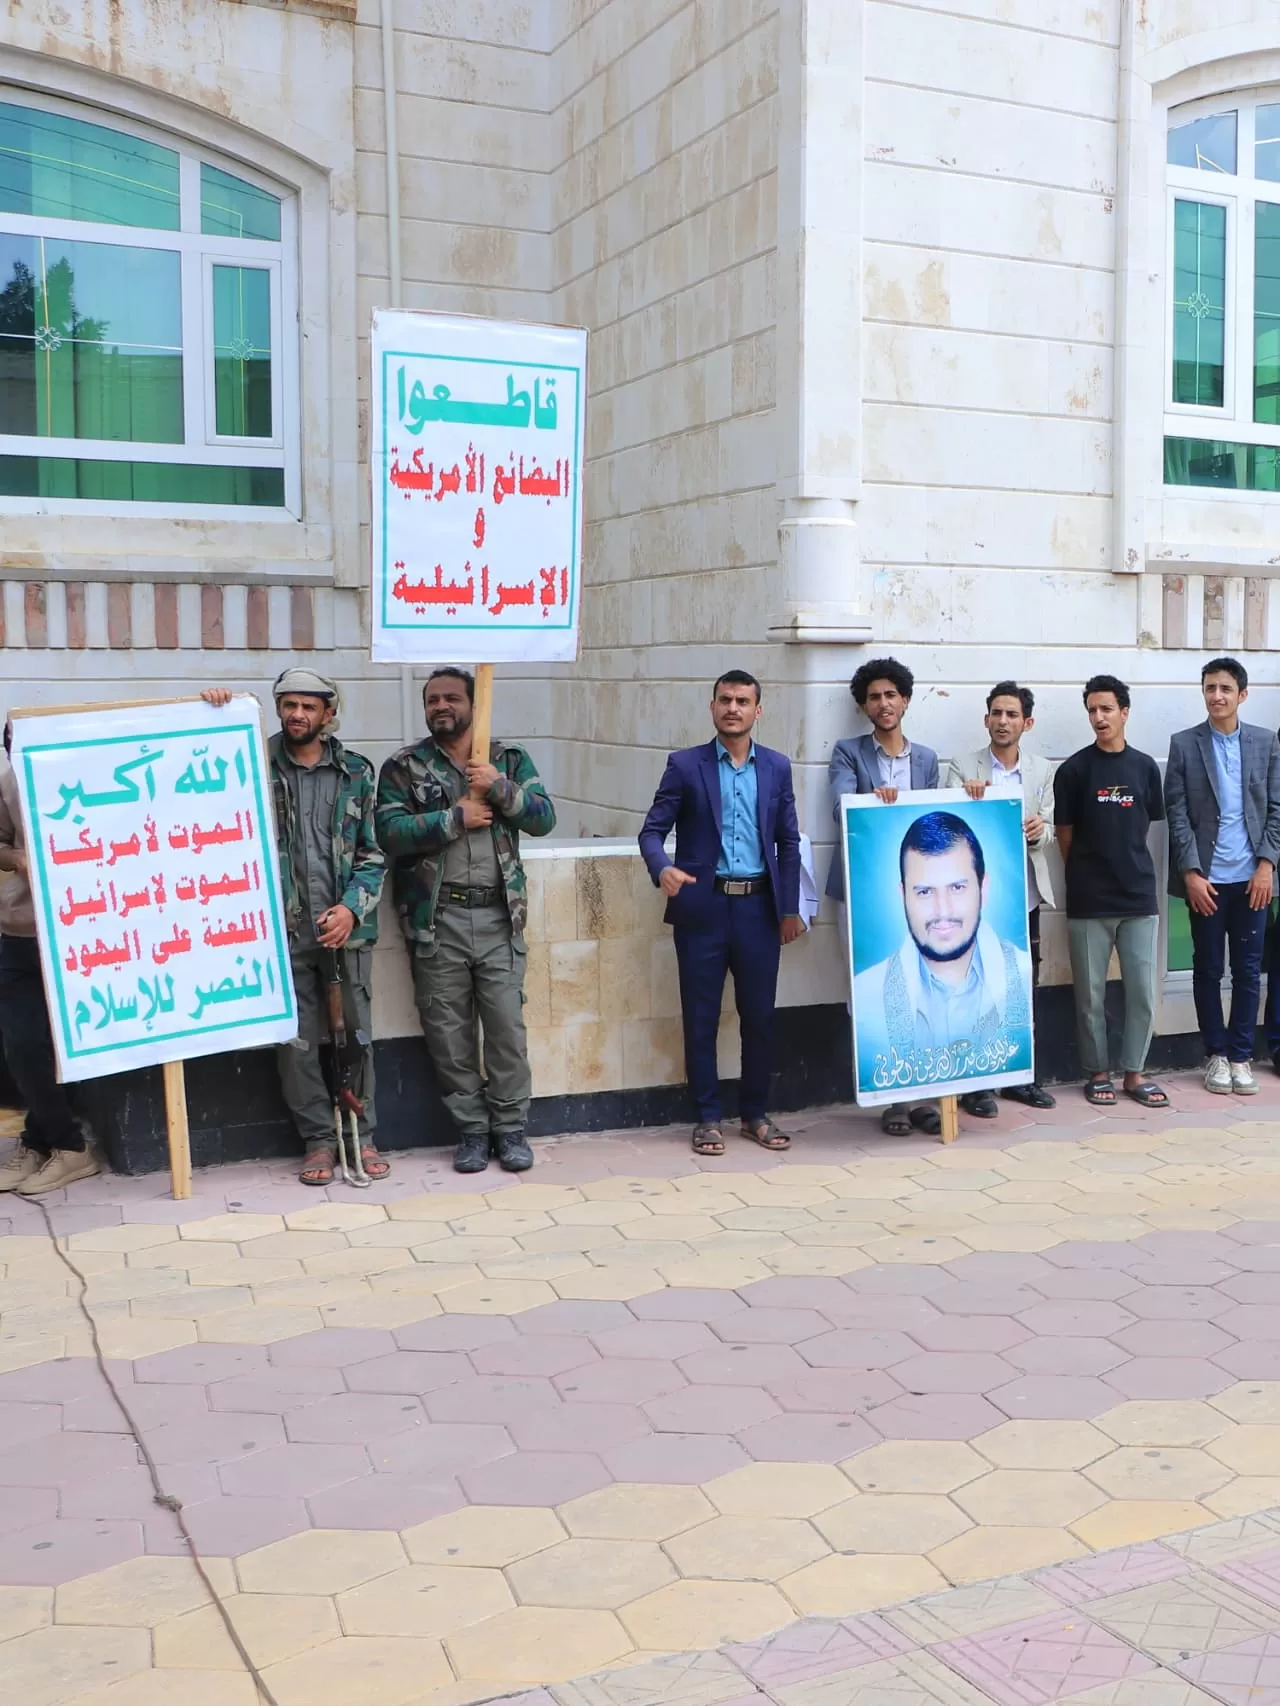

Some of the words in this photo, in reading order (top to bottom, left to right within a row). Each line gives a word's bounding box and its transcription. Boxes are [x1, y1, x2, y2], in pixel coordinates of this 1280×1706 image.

[396, 365, 558, 436] قاطعوا
[389, 441, 486, 502] الأمريكية
[492, 449, 569, 506] البضائع
[472, 506, 486, 549] و
[391, 560, 568, 617] الإسرائيلية
[43, 745, 165, 824] أكبر
[174, 745, 247, 795] الله
[49, 814, 159, 868] لأمريكا
[168, 809, 254, 855] الموت
[58, 872, 167, 927] لإسرائيل
[175, 860, 260, 906] الموت
[65, 926, 142, 978] اليهود
[152, 923, 192, 965] على
[203, 908, 267, 948] اللعنة
[74, 971, 175, 1042] للإسلام
[188, 956, 276, 1020] النصر
